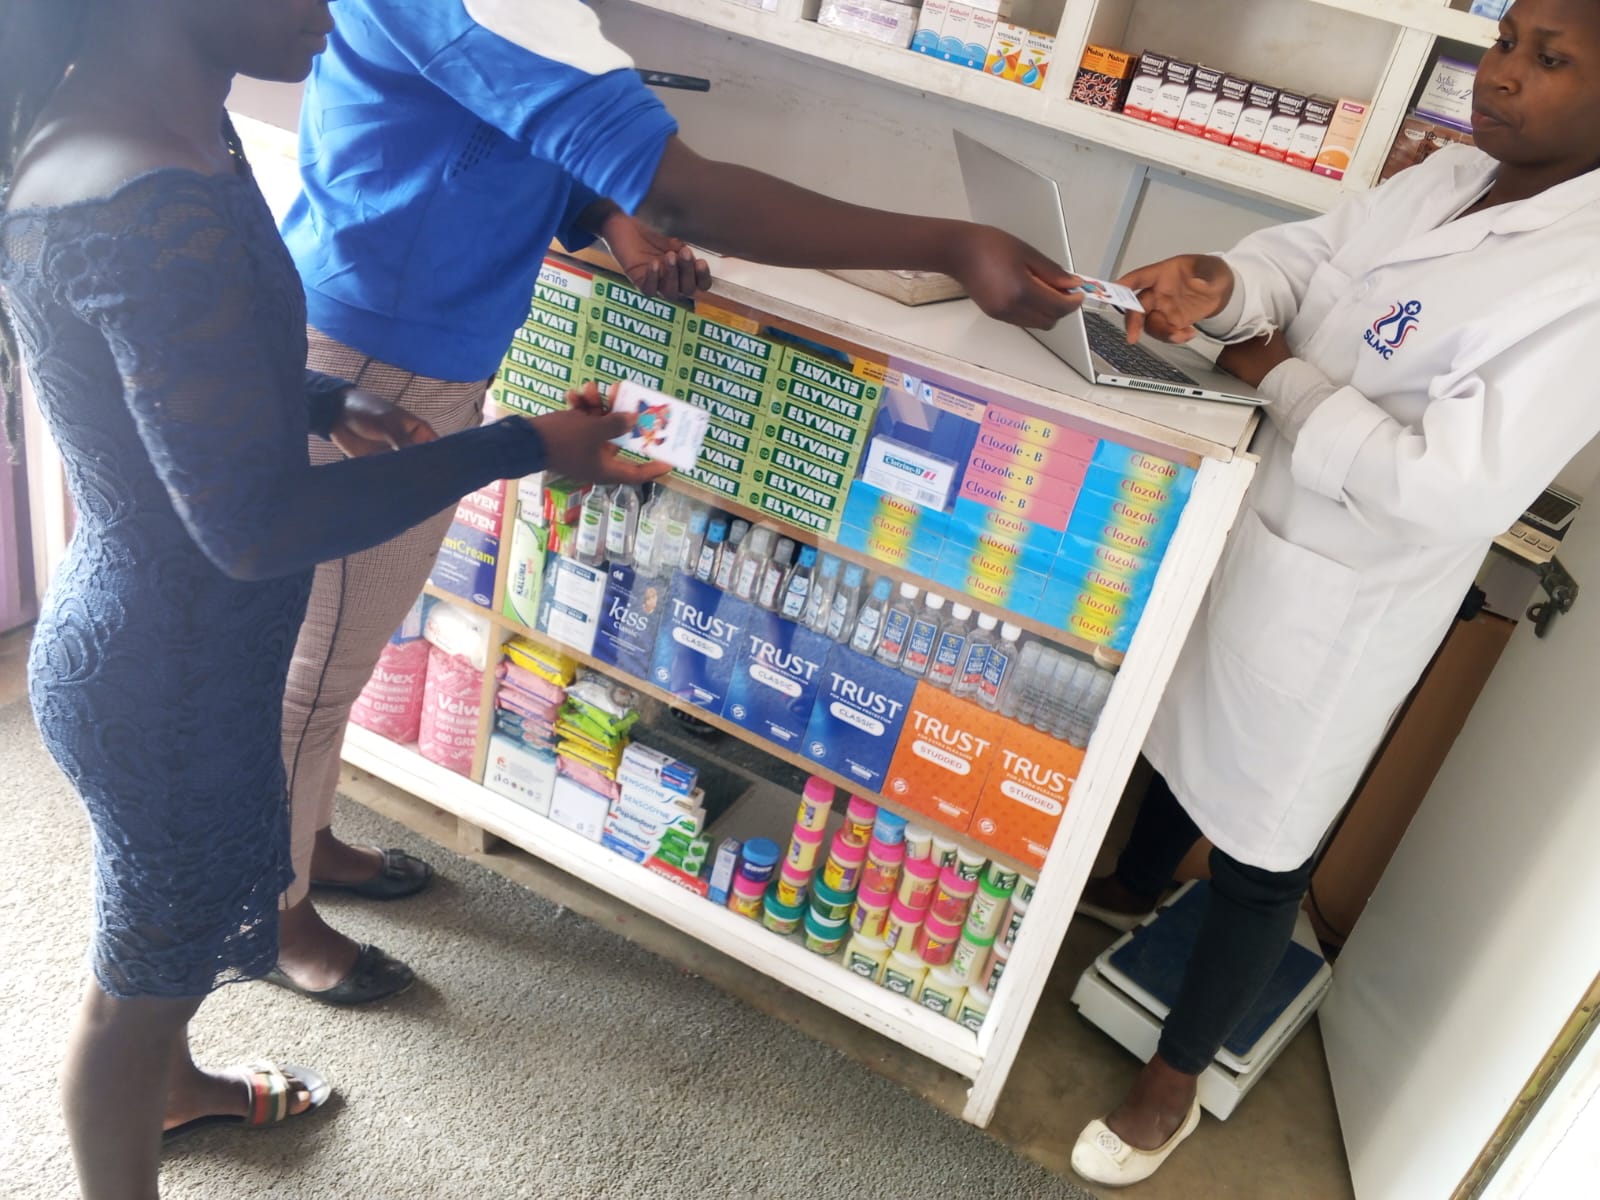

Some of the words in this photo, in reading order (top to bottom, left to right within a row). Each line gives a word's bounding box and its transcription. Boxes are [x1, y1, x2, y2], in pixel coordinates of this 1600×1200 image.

[611, 288, 670, 320] ELYVATE
[607, 311, 666, 344] ELYVATE
[704, 324, 766, 357] ELYVATE
[605, 335, 663, 367] ELYVATE
[1363, 329, 1394, 360] SLMC
[511, 350, 568, 378] ELYVATE
[700, 346, 762, 380] ELYVATE
[695, 370, 758, 404] ELYVATE
[796, 360, 860, 397] ELYVATE
[794, 384, 857, 418] ELYVATE
[788, 406, 851, 441] ELYVATE
[988, 410, 1031, 432] Clozole
[1042, 428, 1051, 438] B
[782, 430, 844, 464] ELYVATE
[981, 434, 1023, 456] Clozole
[1034, 452, 1042, 462] B
[776, 452, 838, 486] ELYVATE
[973, 457, 1014, 480] Clozole
[1025, 475, 1034, 486] B
[1130, 454, 1177, 478] Clozole
[770, 475, 831, 508] ELYVATE
[966, 480, 1007, 503] Clozole
[1018, 498, 1026, 508] B
[1121, 479, 1168, 502] Clozole
[766, 497, 826, 530] ELYVATE
[880, 494, 919, 516] Clozole
[1112, 502, 1159, 525] Clozole
[873, 515, 912, 537] Clozole
[987, 511, 1029, 533] Clozole
[868, 538, 907, 559] Clozole
[979, 534, 1021, 556] Clozole
[1104, 525, 1150, 548] Clozole
[971, 554, 1013, 576] Clozole
[1096, 547, 1141, 570] Clozole
[967, 575, 1007, 598] Clozole
[1087, 571, 1131, 594] Clozole
[609, 596, 648, 630] kiss
[1078, 592, 1121, 617] Clozole
[672, 598, 738, 642] TRUST
[1070, 614, 1114, 637] Clozole
[750, 635, 819, 680] TRUST
[759, 671, 793, 691] CLASSIC
[831, 672, 903, 719] TRUST
[839, 708, 876, 730] CLASSIC
[913, 710, 990, 757] TRUST
[920, 745, 962, 771] STUDDED
[1009, 786, 1054, 810] STUDDED
